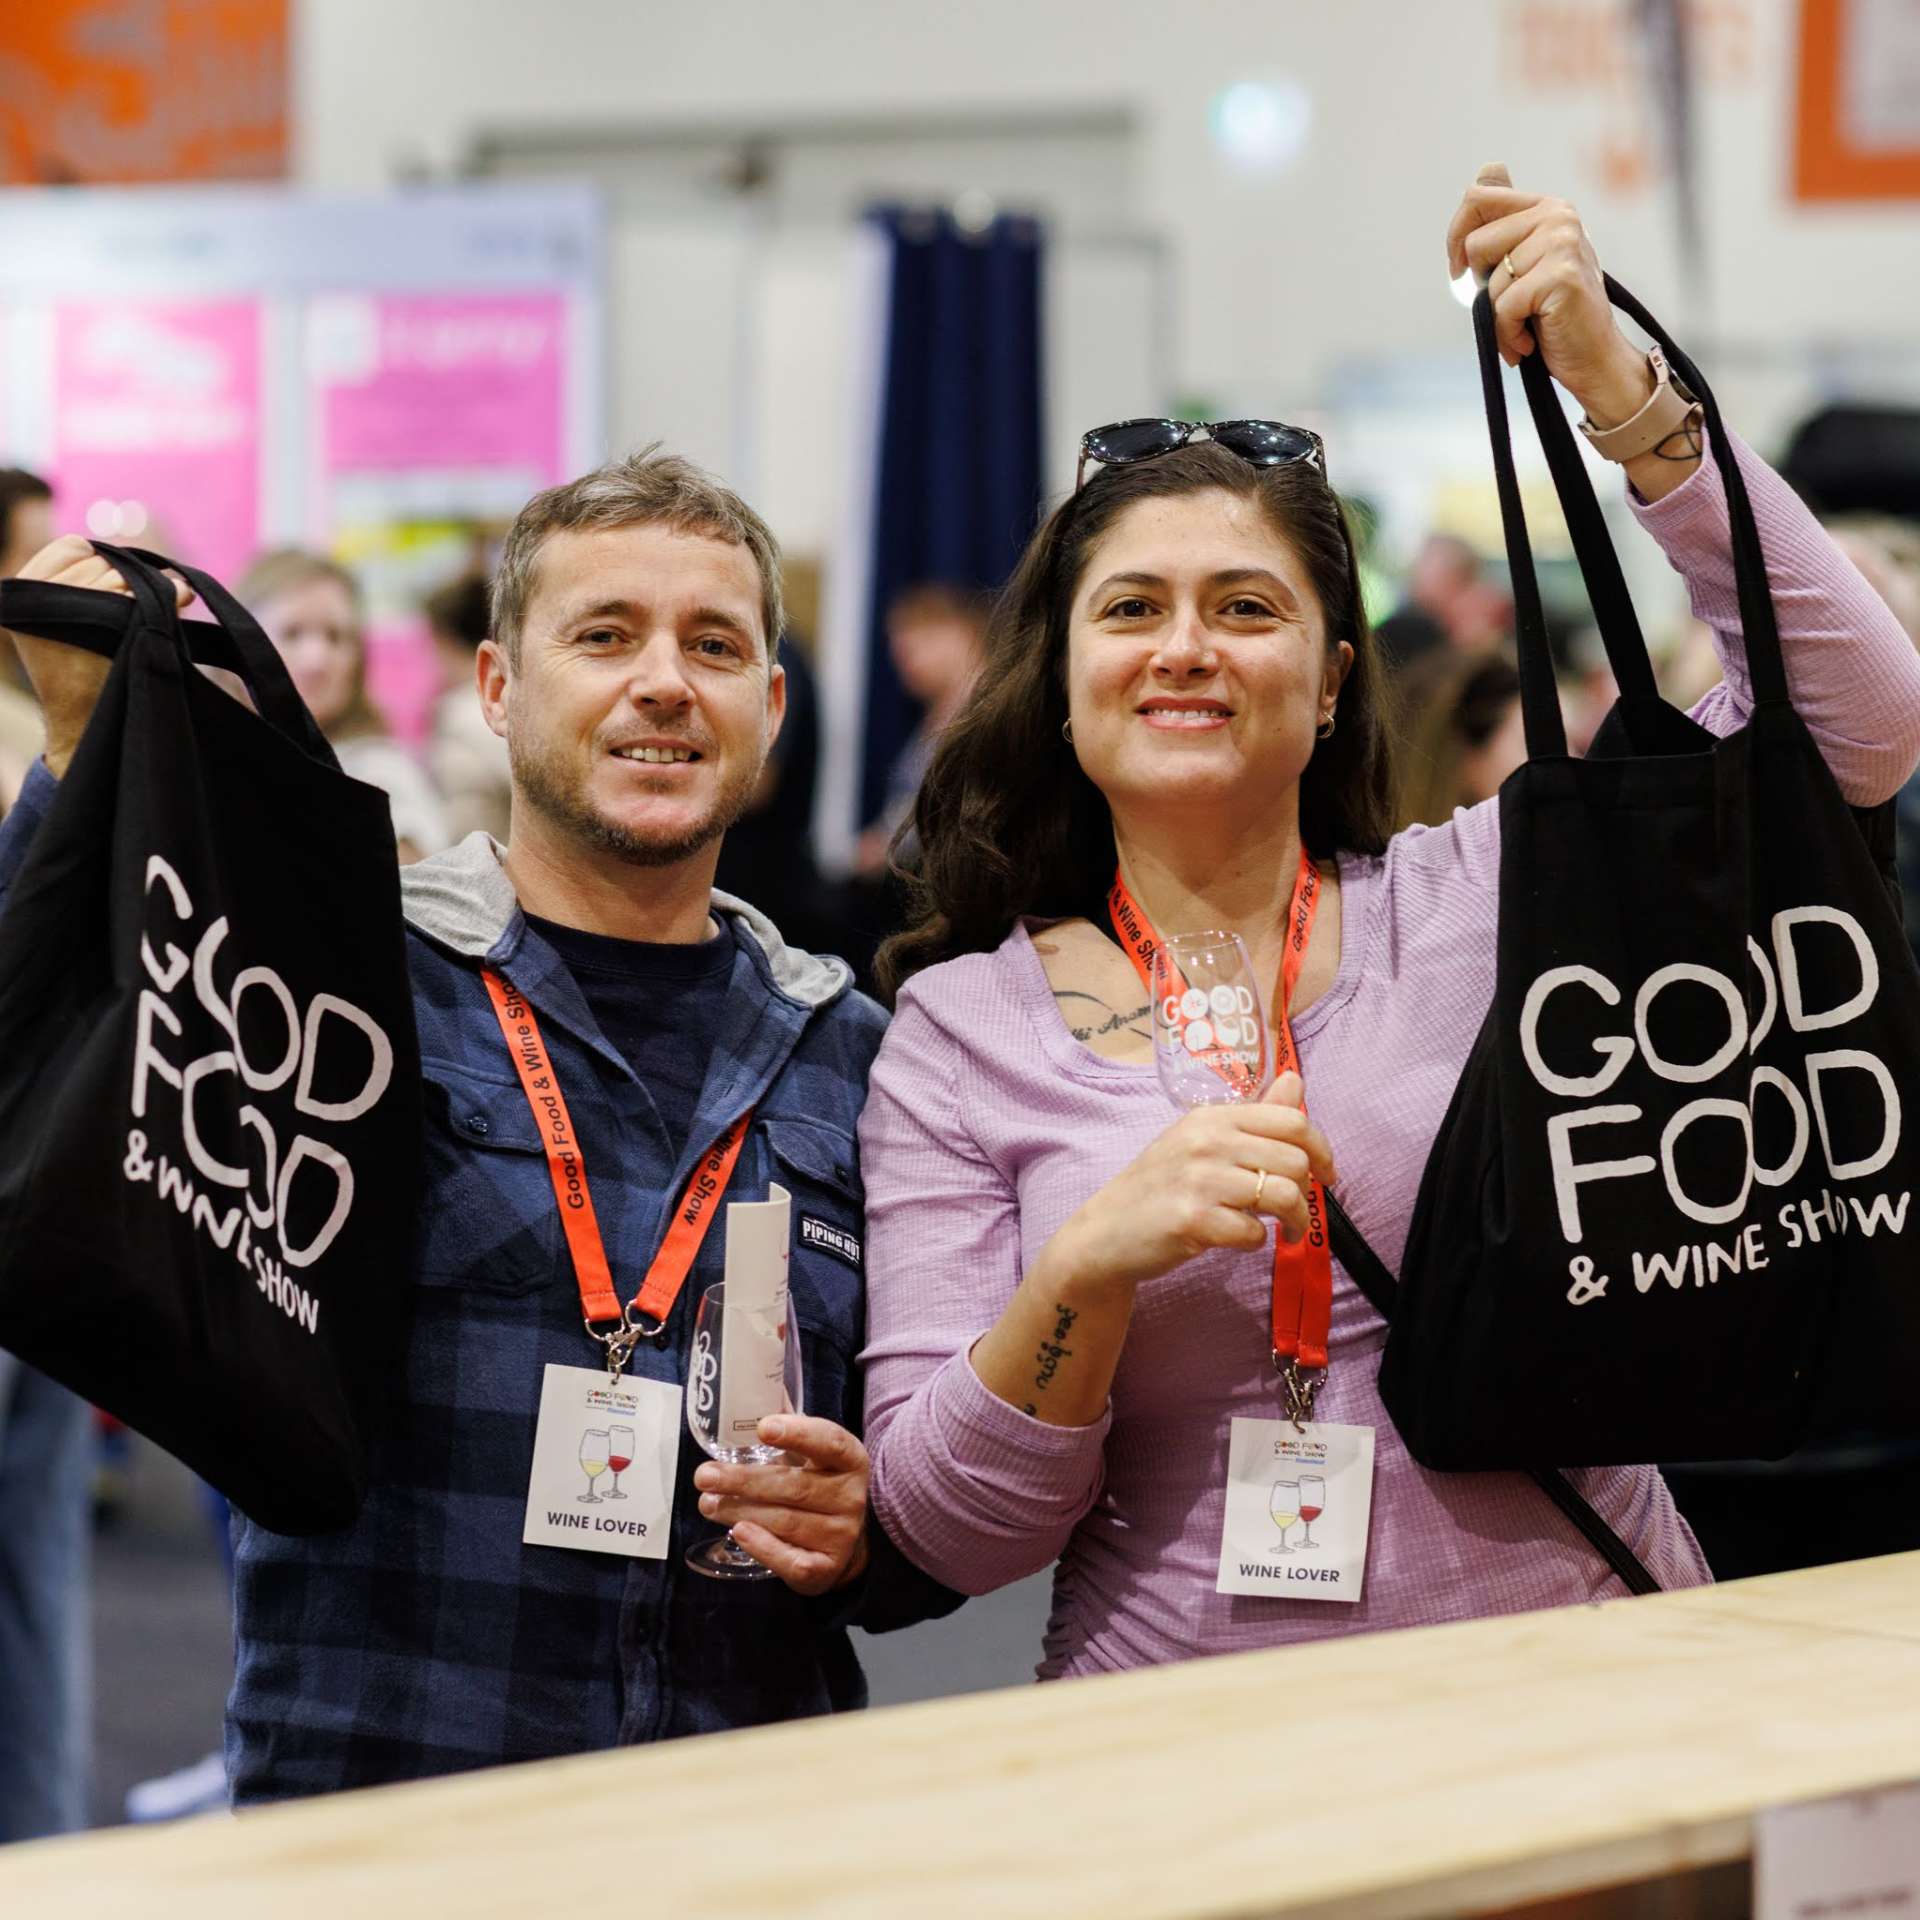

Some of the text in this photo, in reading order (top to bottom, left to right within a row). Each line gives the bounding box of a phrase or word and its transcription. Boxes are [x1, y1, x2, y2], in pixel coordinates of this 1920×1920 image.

[1118, 900, 1142, 942] Wine
[502, 981, 584, 1209] Good Food & Wine Sho
[1547, 1050, 1902, 1244] FOOD
[684, 1174, 717, 1226] Show
[123, 1129, 155, 1182] &
[253, 1246, 320, 1334] SHOW
[802, 1220, 843, 1249] PIPING
[1566, 1255, 1609, 1306] &
[1631, 1223, 1770, 1294] WINE
[547, 1511, 648, 1537] WINE LOVER
[1239, 1563, 1340, 1583] WINE LOVER
